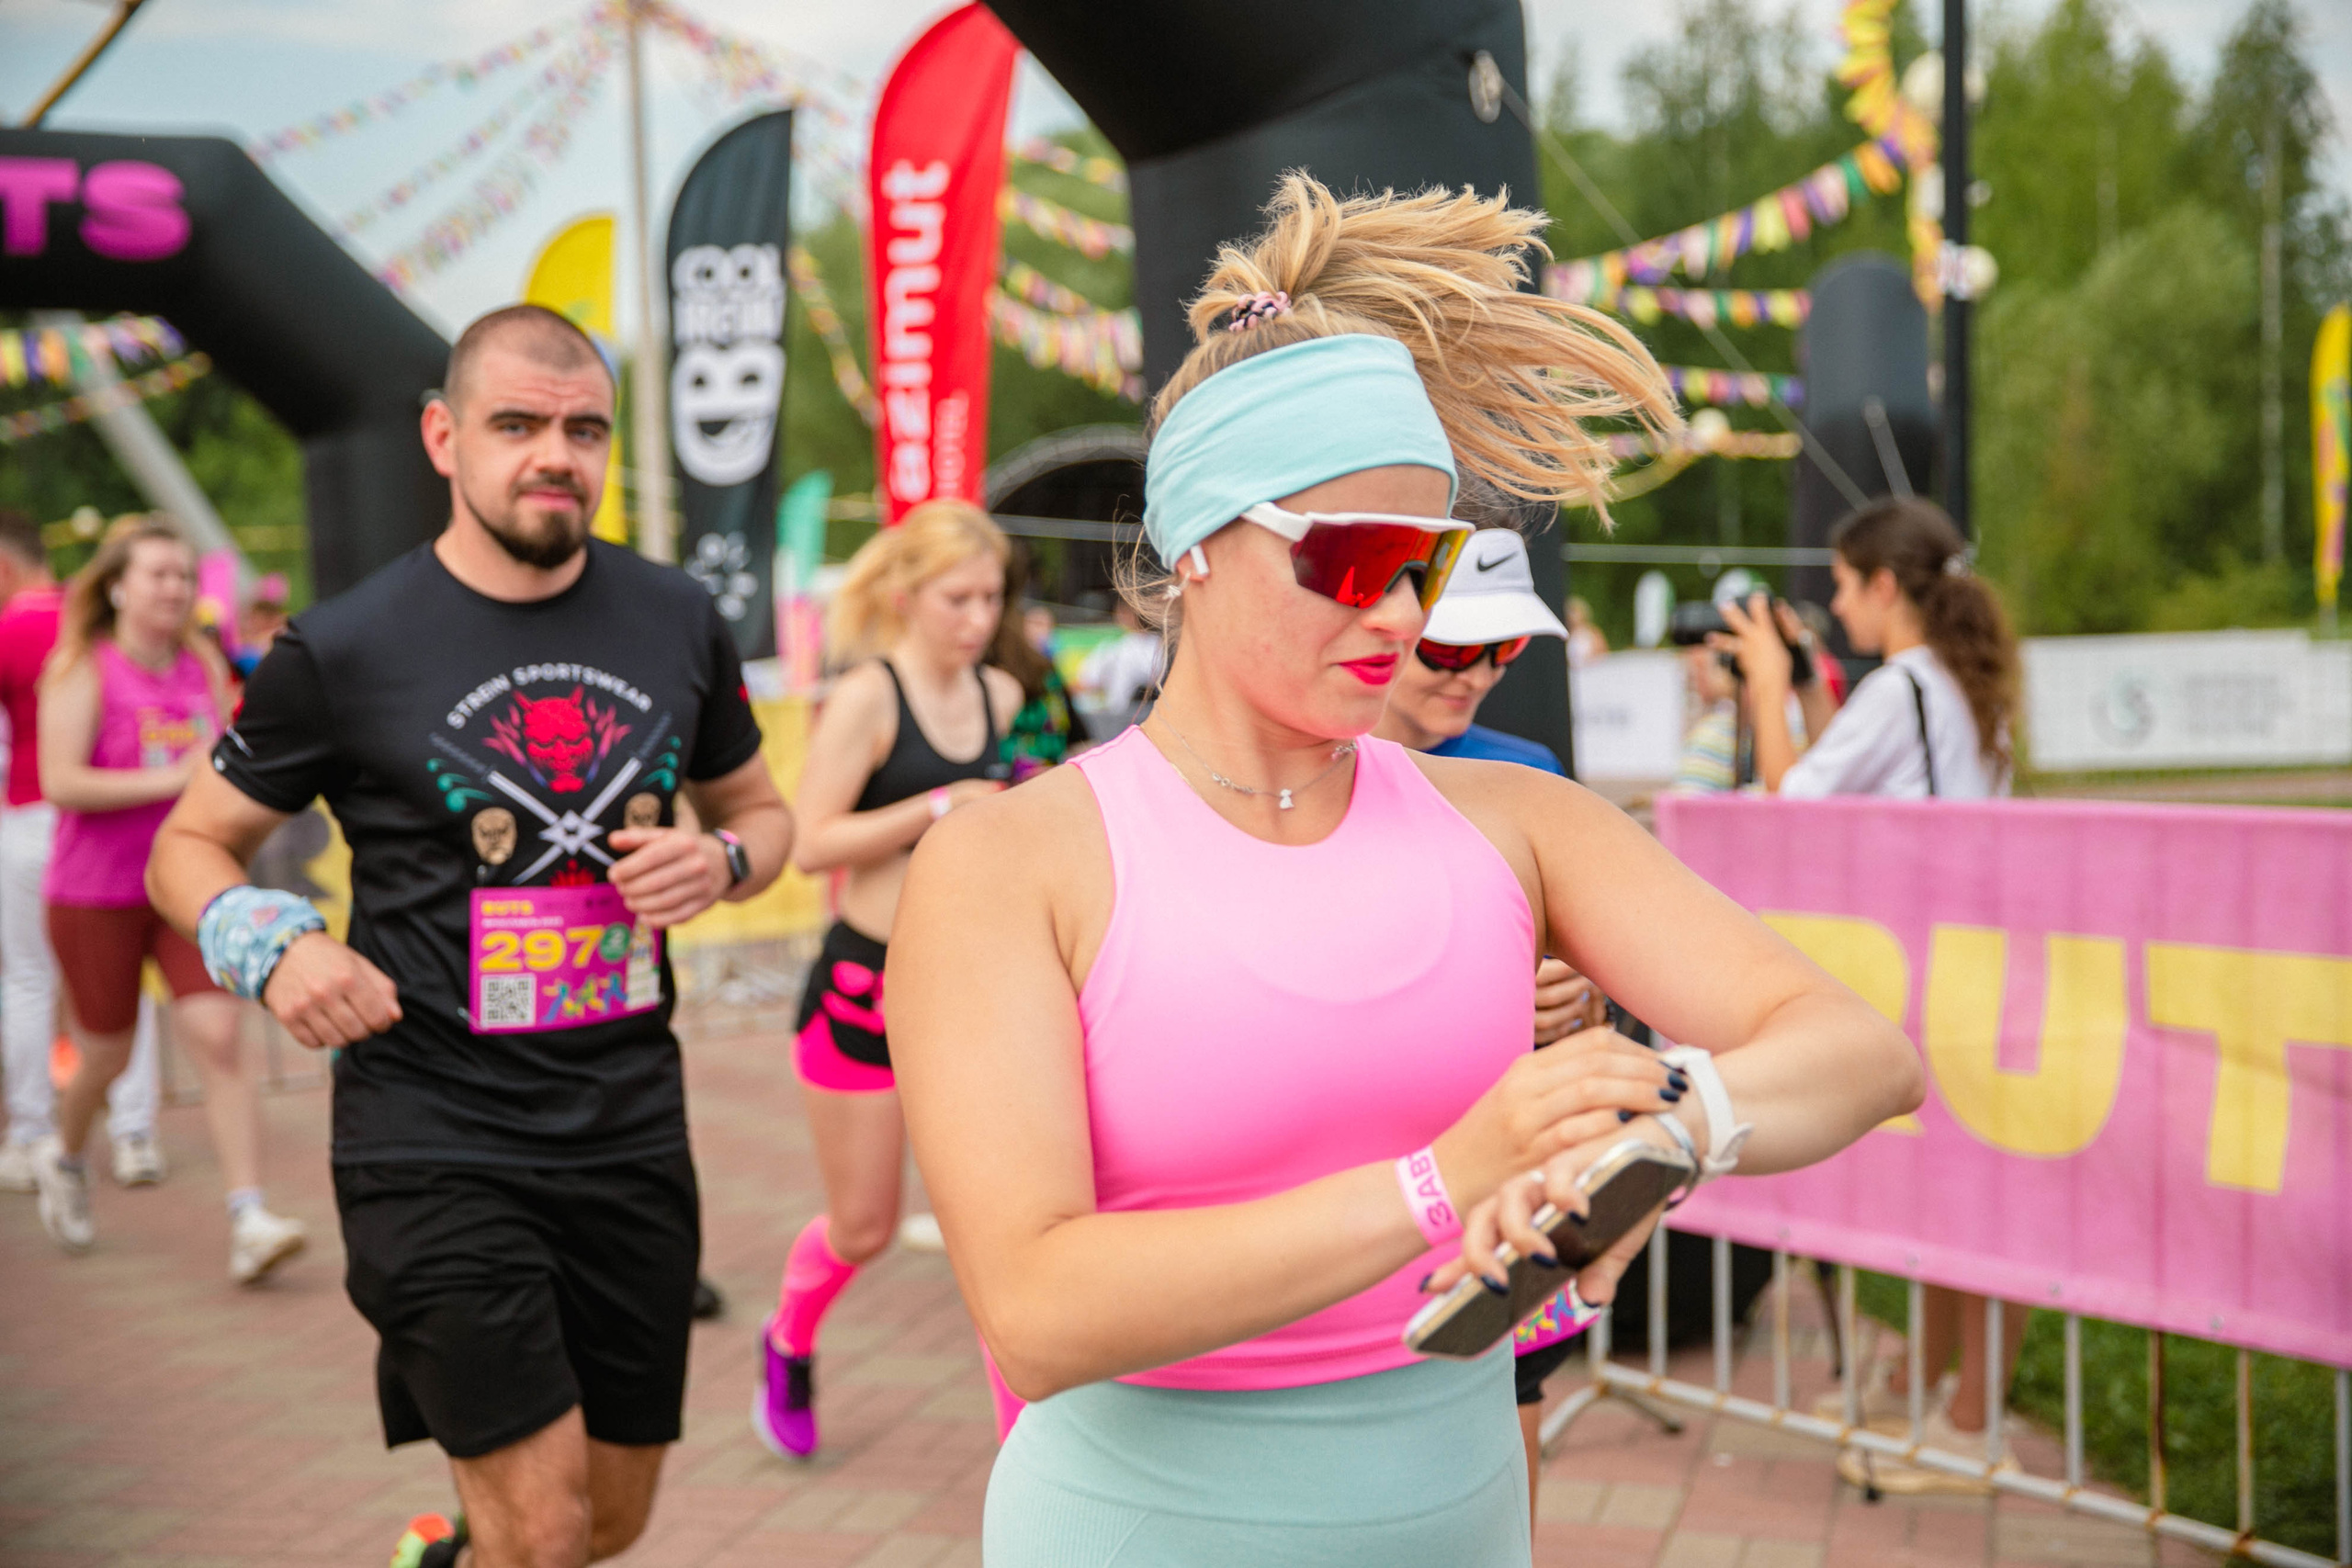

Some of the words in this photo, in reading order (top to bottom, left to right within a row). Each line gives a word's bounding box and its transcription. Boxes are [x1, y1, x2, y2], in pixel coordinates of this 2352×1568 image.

[0, 157, 192, 262] TS
[879, 158, 950, 503] azimut
[512, 662, 653, 713] SPORTSWEAR
[479, 924, 605, 973] 297
